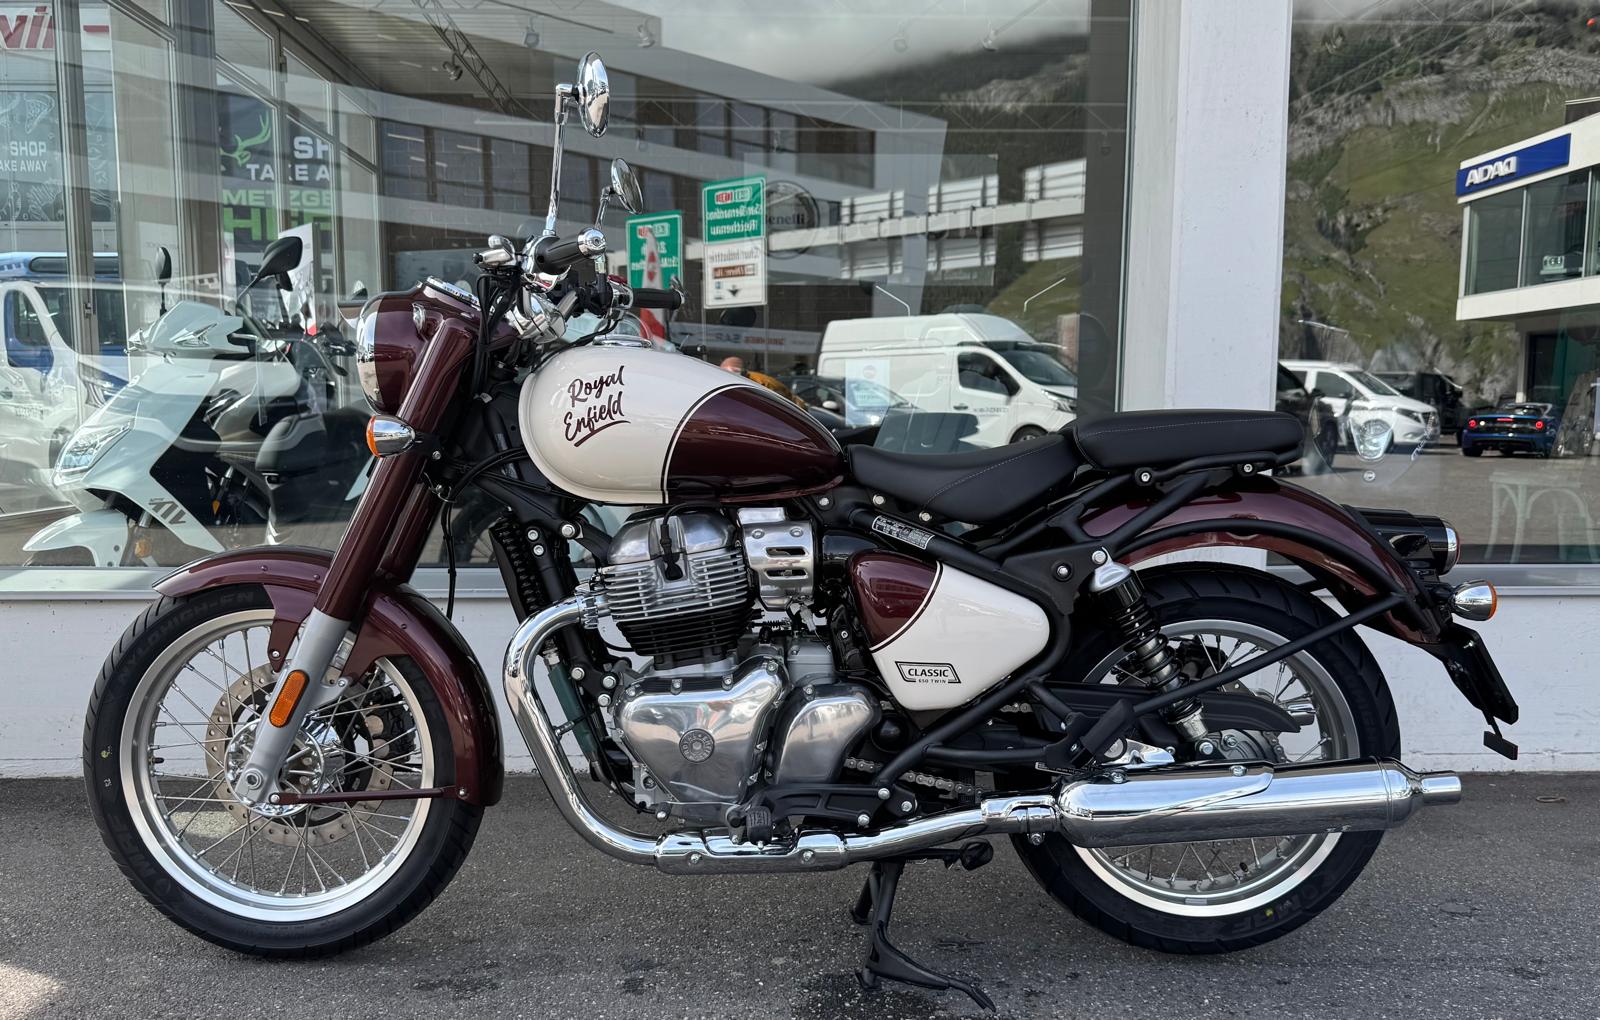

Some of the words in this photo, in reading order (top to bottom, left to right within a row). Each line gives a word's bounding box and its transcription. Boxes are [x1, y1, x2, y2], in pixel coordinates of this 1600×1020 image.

[10, 140, 47, 156] SHOP
[20, 160, 47, 172] AWAY
[246, 164, 309, 180] TAE
[760, 214, 805, 226] enelli
[567, 365, 625, 407] Royal
[564, 391, 625, 441] Enfield
[908, 668, 949, 677] CLASSIC
